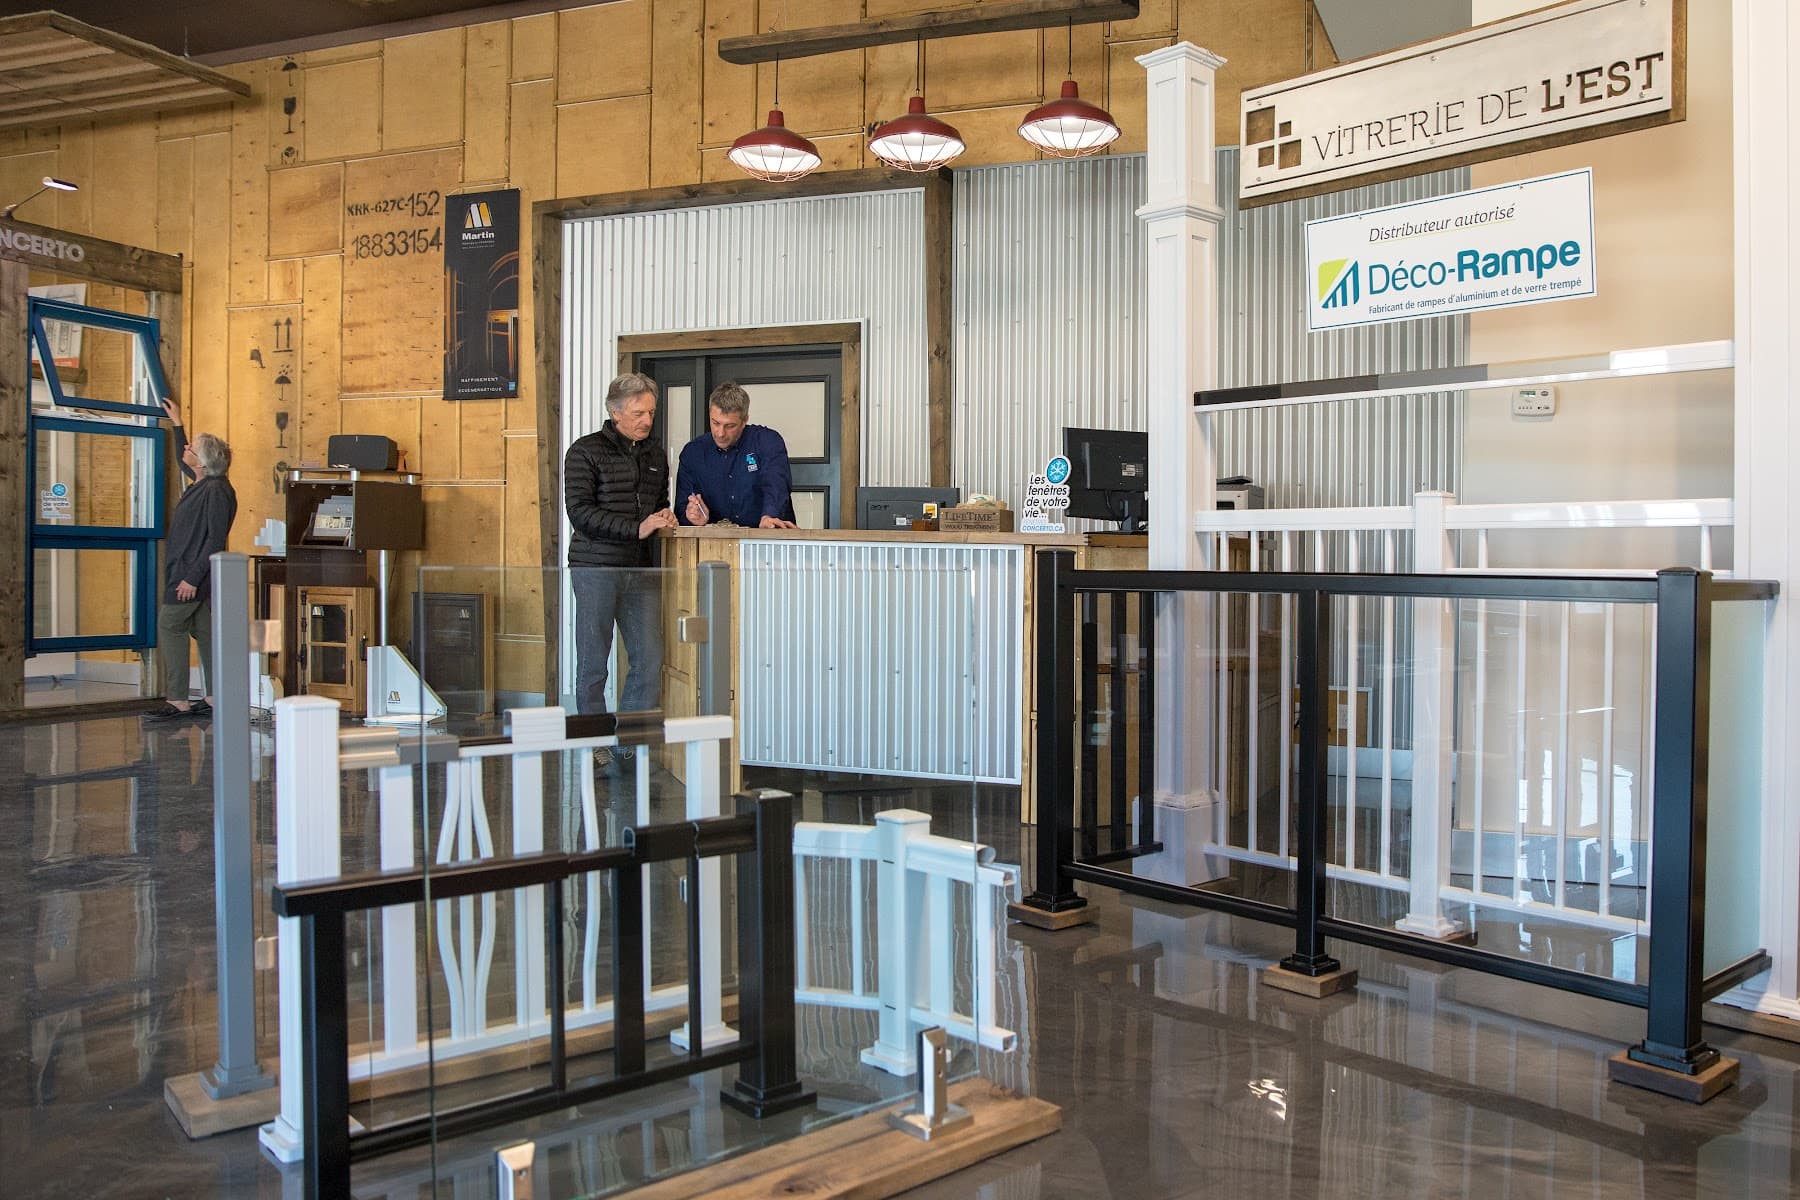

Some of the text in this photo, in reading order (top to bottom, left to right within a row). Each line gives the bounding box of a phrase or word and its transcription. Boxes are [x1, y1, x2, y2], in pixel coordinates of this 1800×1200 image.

[1477, 86, 1528, 126] DE
[1541, 52, 1664, 113] L'EST
[462, 231, 495, 241] Martin
[1369, 202, 1516, 243] Distributeur autorisé
[351, 226, 443, 260] 18833154
[1368, 240, 1581, 295] Déco-Rampe
[1369, 277, 1582, 315] Fabricant de rampes d'aluminium et de verre trempé
[1028, 485, 1067, 496] fenêtres
[1029, 474, 1046, 485] Les
[1026, 497, 1068, 507] de votre
